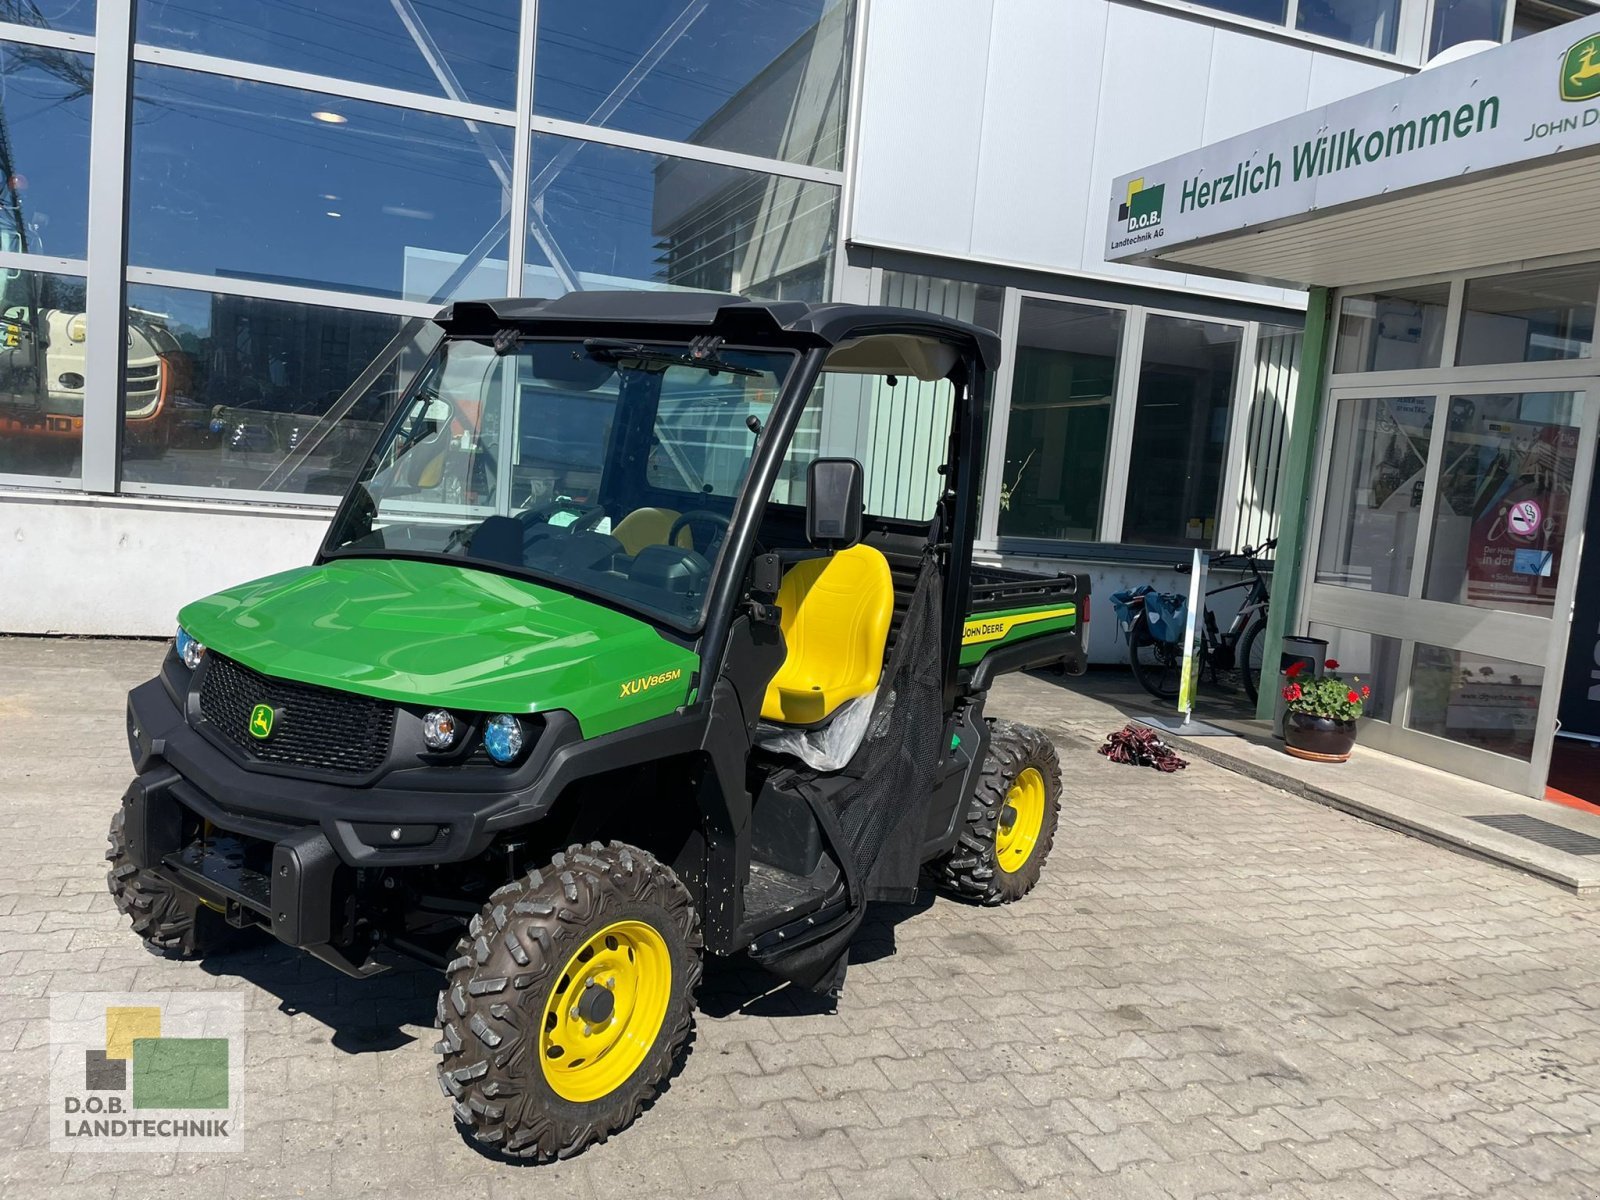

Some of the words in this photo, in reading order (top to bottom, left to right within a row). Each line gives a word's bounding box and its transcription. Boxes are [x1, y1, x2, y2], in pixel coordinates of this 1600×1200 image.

[1524, 115, 1578, 142] JOHN
[1583, 108, 1600, 127] D
[1180, 153, 1281, 213] Herzlich
[1293, 95, 1499, 182] Willkommen
[1129, 211, 1160, 231] D.O.B.
[1111, 229, 1152, 250] Landtechnik
[1153, 228, 1164, 239] AG
[1495, 554, 1512, 565] der
[962, 627, 981, 638] JOHN
[982, 624, 1003, 635] DEERE
[620, 668, 681, 698] XUV865M
